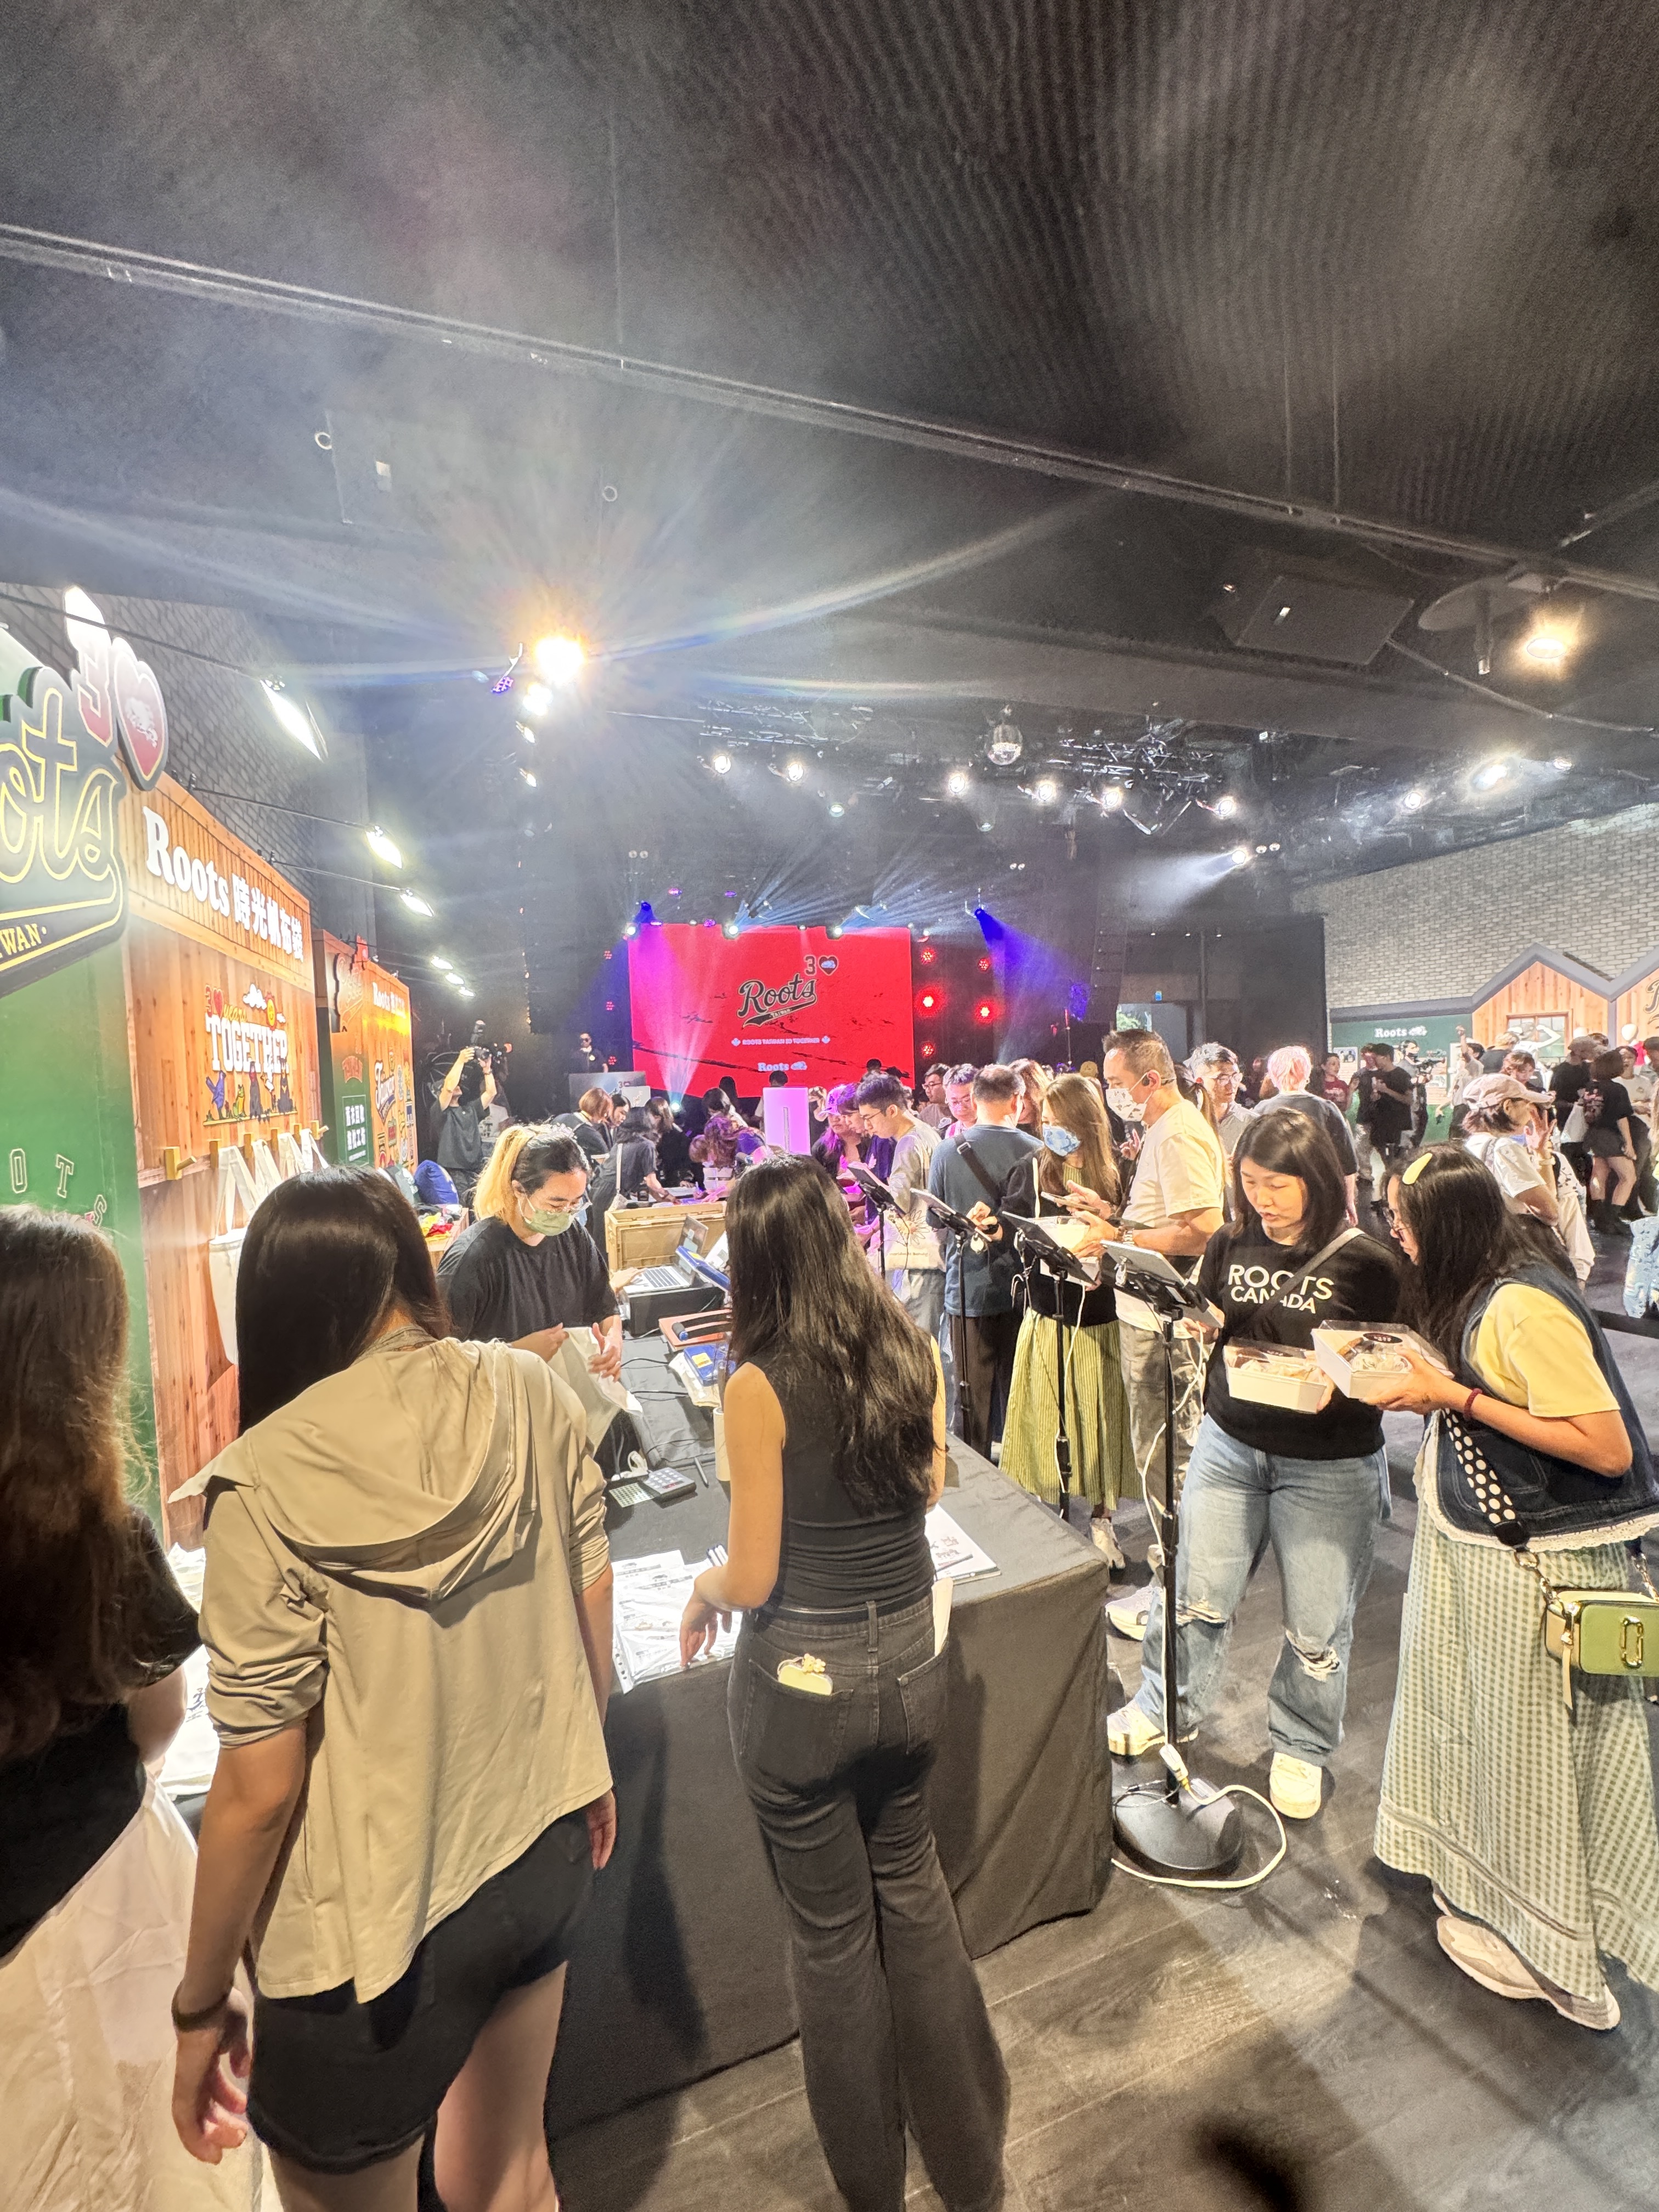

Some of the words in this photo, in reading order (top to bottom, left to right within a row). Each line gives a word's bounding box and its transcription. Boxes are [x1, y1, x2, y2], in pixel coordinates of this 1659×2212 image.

[143, 806, 230, 917] Roots
[0, 923, 42, 958] WAN
[804, 955, 816, 976] 3
[737, 973, 817, 1018] Roots
[205, 1012, 290, 1075] TOGETHER
[1374, 1028, 1408, 1038] Roots
[758, 1062, 789, 1071] Roots
[1228, 1264, 1334, 1300] ROOTS
